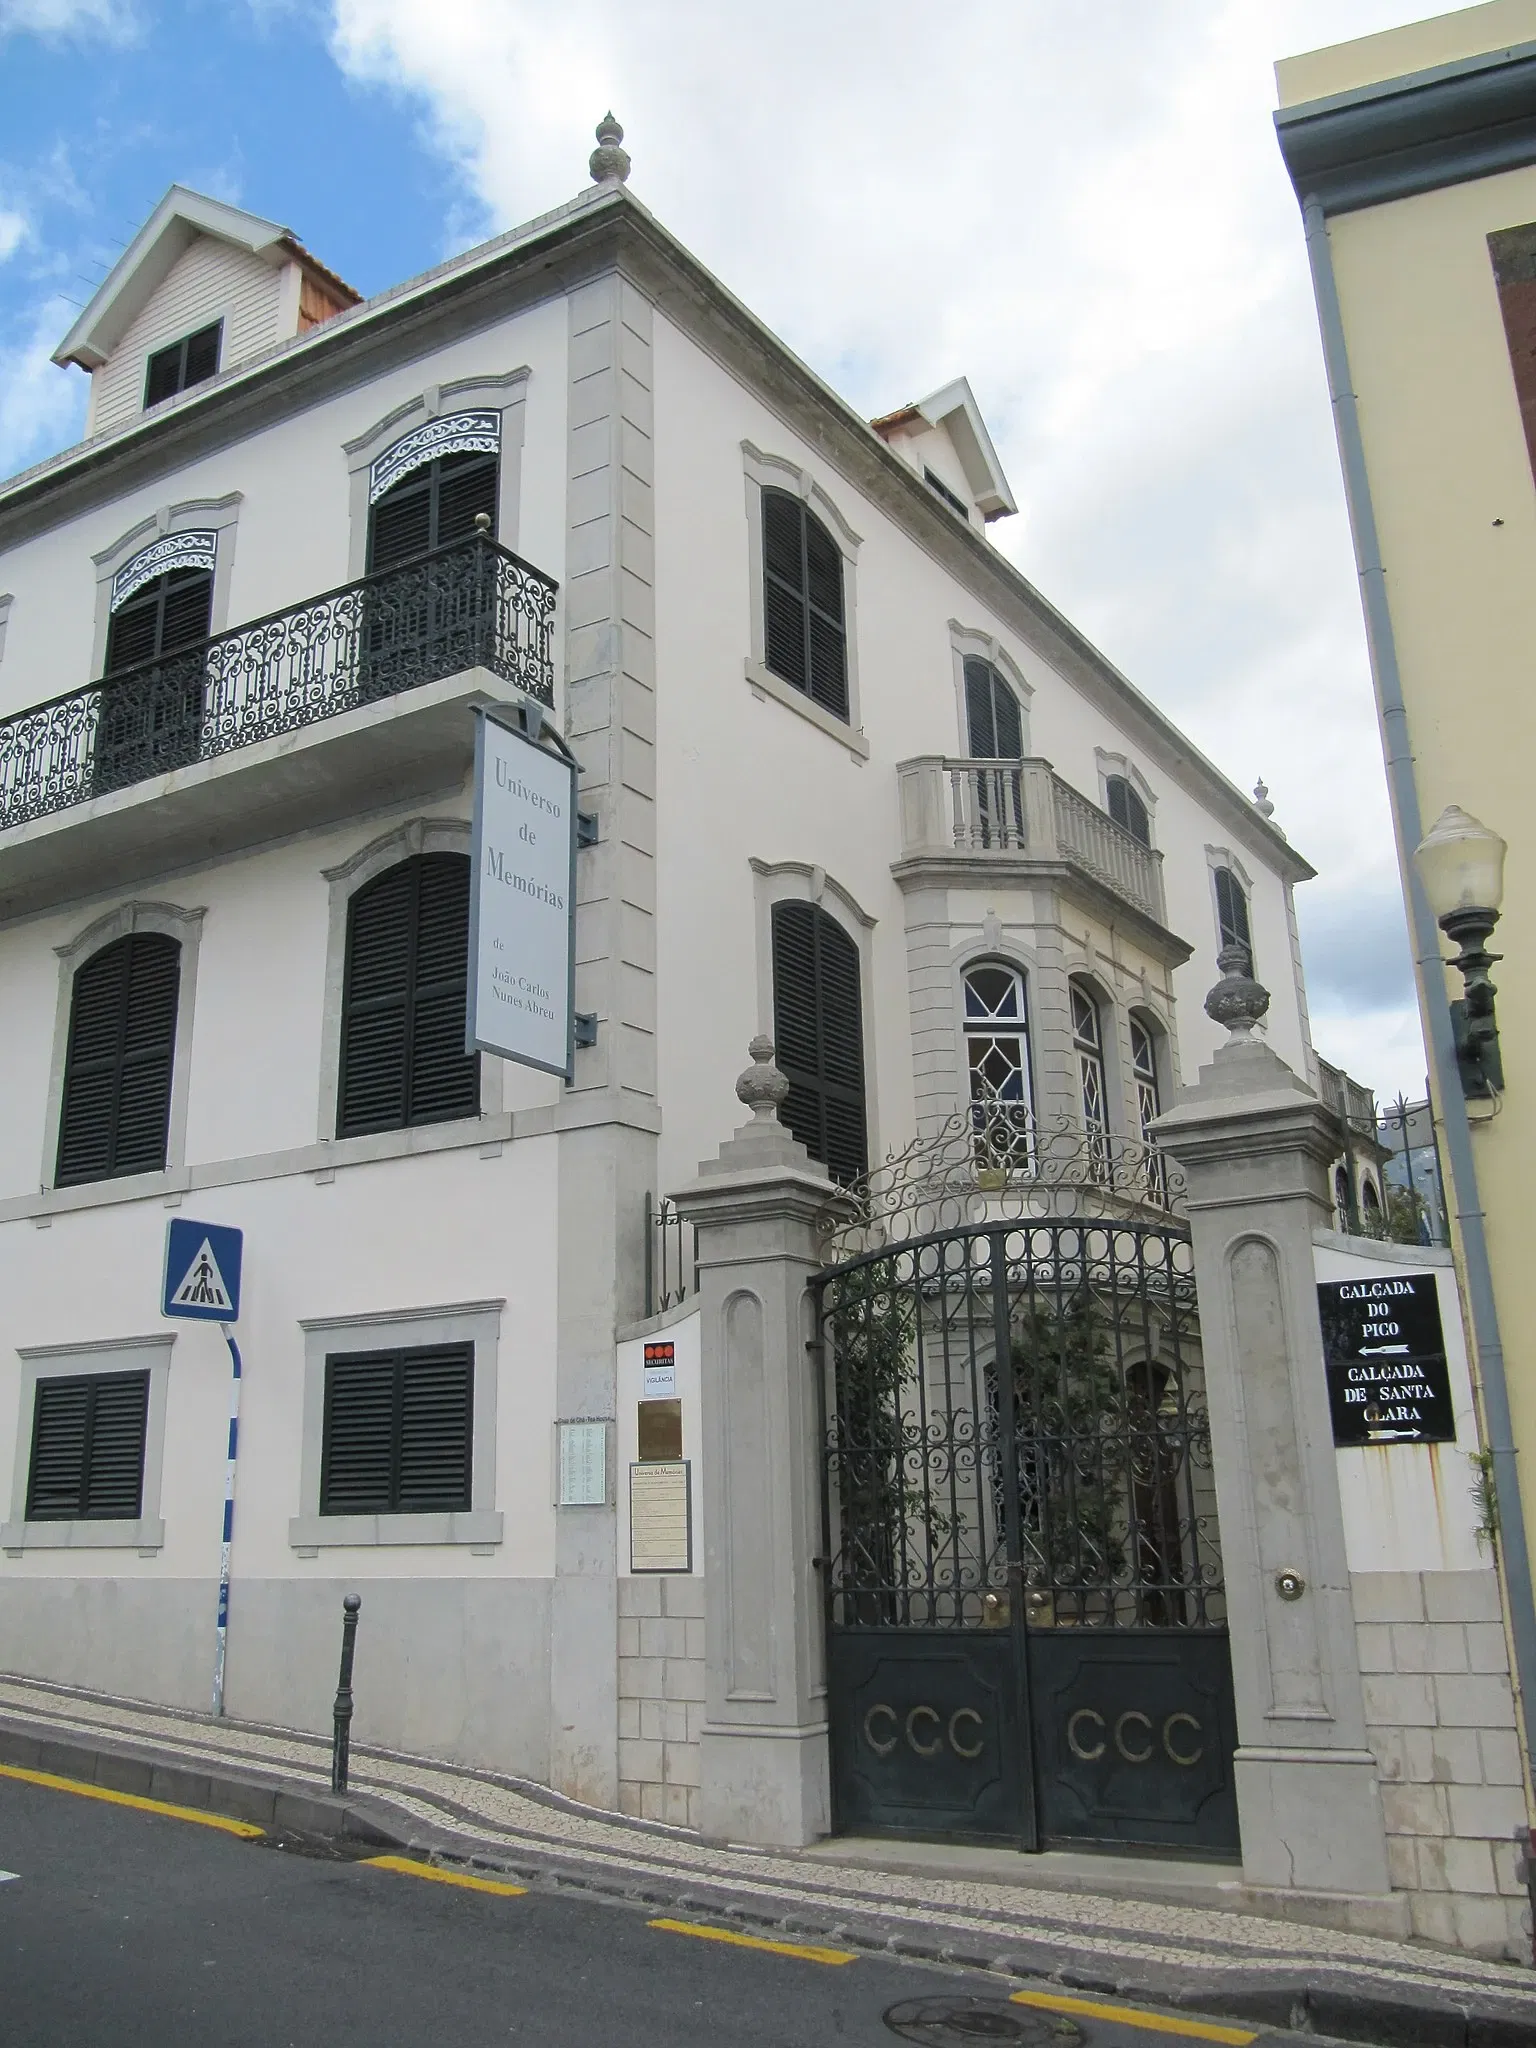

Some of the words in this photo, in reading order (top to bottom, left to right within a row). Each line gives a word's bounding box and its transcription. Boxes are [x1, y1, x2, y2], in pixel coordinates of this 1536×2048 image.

[495, 756, 561, 819] Universo
[519, 823, 536, 846] de
[486, 846, 564, 910] Memórias
[493, 937, 504, 951] de
[492, 967, 516, 988] João
[518, 976, 550, 1000] Carlos
[492, 985, 522, 1010] Nunes
[525, 998, 554, 1020] Abreu
[1339, 1281, 1415, 1299] CALÇADA
[1368, 1302, 1389, 1317] DO
[1362, 1322, 1399, 1338] PICO
[645, 1358, 674, 1366] SECURITAS
[646, 1376, 673, 1384] VIGILÂNCIA
[1347, 1364, 1425, 1382] CALÇADA
[1344, 1387, 1367, 1403] DE
[1379, 1384, 1435, 1401] SANTA
